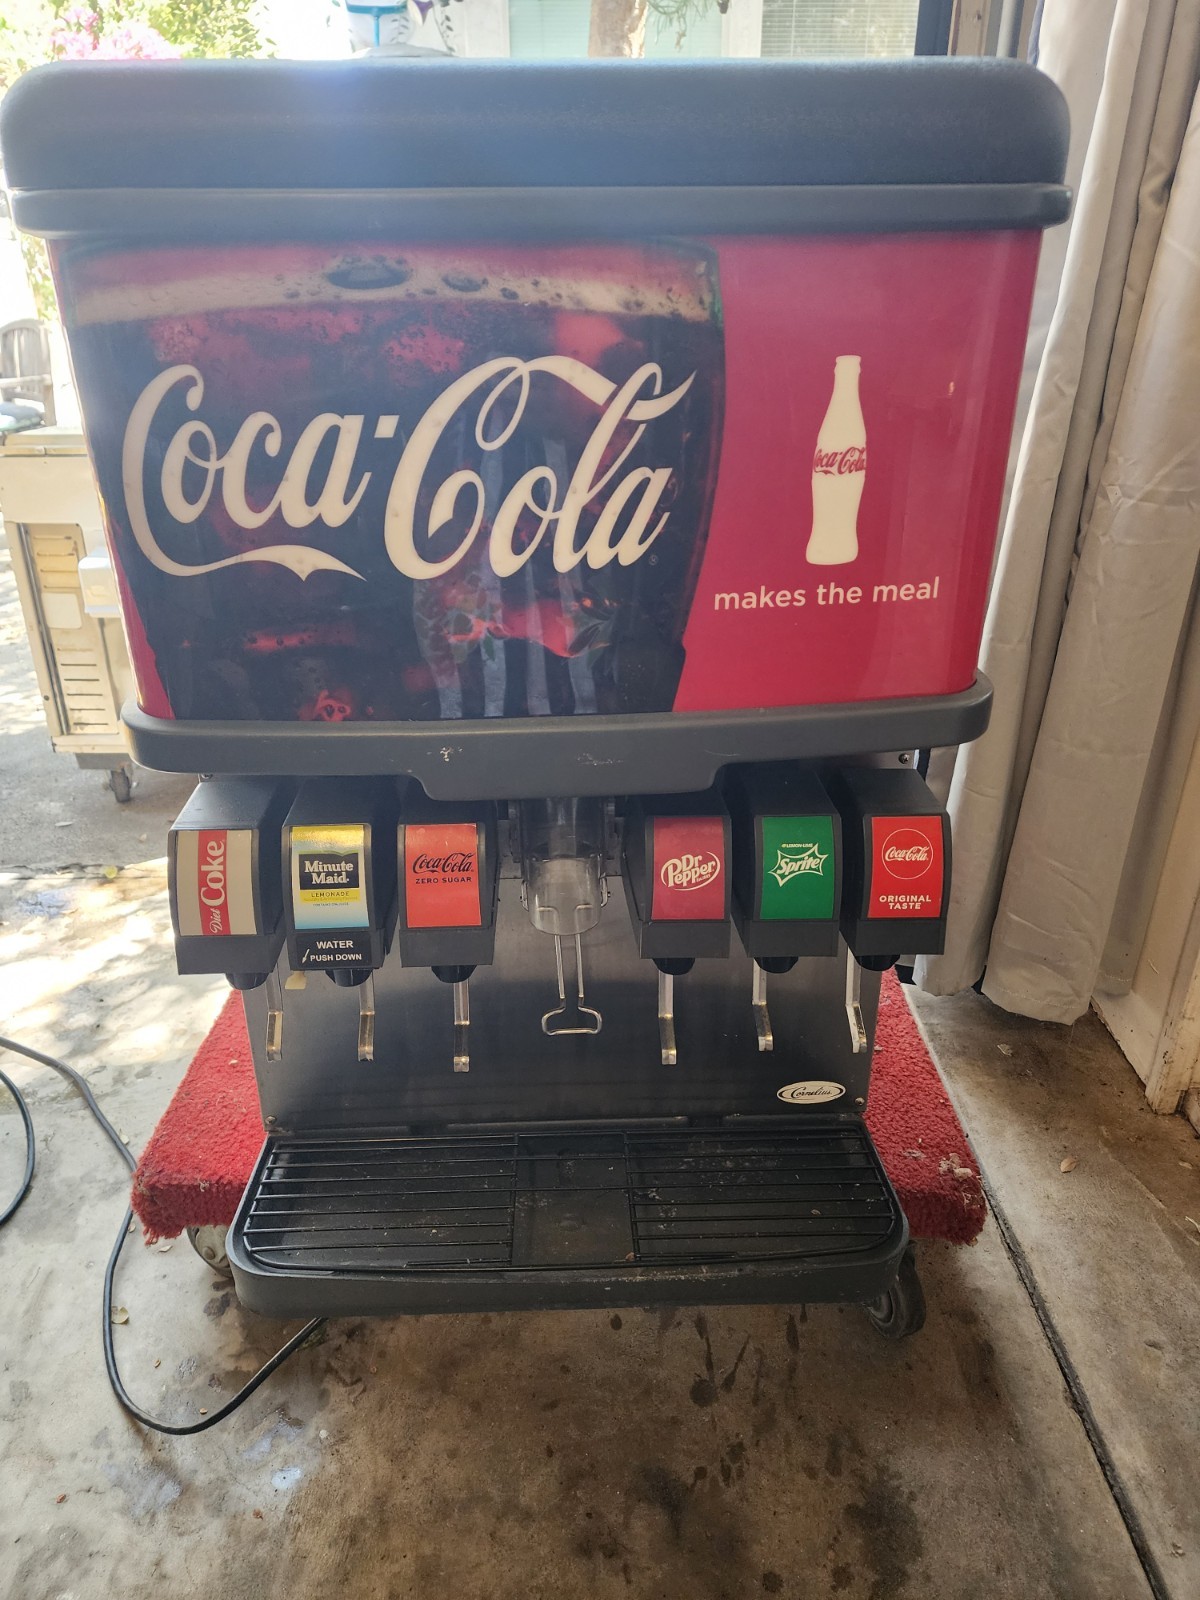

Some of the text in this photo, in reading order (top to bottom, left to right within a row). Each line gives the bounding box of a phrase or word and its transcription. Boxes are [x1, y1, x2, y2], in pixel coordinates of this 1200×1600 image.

[122, 355, 697, 581] Coca-Cola
[714, 576, 940, 610] makes the meal
[885, 846, 930, 862] Coca-Cola
[304, 860, 354, 872] Minute
[412, 852, 477, 874] Coca-Cola
[681, 854, 702, 872] Dr
[776, 855, 821, 875] Sprite
[311, 872, 347, 885] Maid
[661, 858, 716, 888] Pepper
[415, 876, 472, 885] ZERO SUGAR
[200, 841, 226, 934] Diet Coke
[311, 890, 350, 898] LEMONADE
[879, 894, 931, 903] ORIGINAL
[888, 902, 921, 910] TASTE
[316, 940, 354, 950] WATER
[310, 953, 362, 962] PUSH DOWN
[790, 1086, 831, 1099] Cornelius
